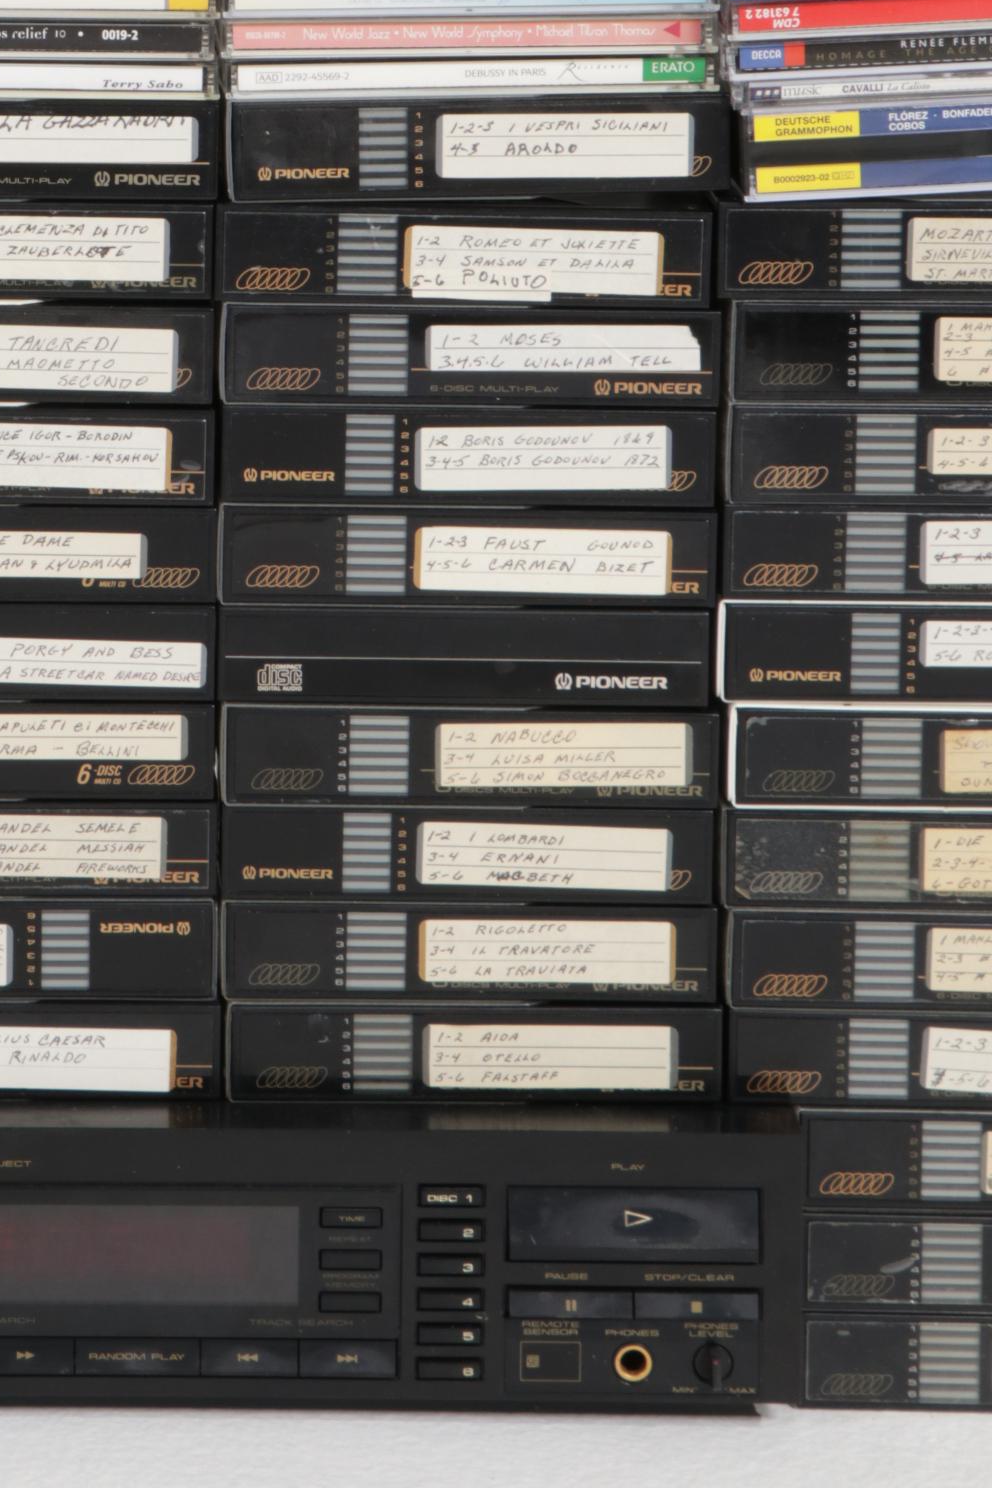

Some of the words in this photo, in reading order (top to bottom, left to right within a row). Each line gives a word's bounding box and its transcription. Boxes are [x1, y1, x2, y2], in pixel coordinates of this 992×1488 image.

[652, 62, 695, 73] ERATO
[115, 174, 200, 185] PIONEER
[275, 168, 349, 179] PIONEER
[4, 336, 122, 353] TANCREDI
[614, 382, 701, 394] PIONEER
[22, 534, 74, 547] DAME
[489, 558, 576, 572] CARMEN
[596, 559, 655, 574] BIZET
[10, 643, 73, 657] PORGY
[82, 647, 115, 658] AND
[130, 647, 173, 659] BESS
[576, 676, 667, 689] PIONEER
[76, 740, 139, 757] BELLINI
[38, 1034, 105, 1048] CAESAR
